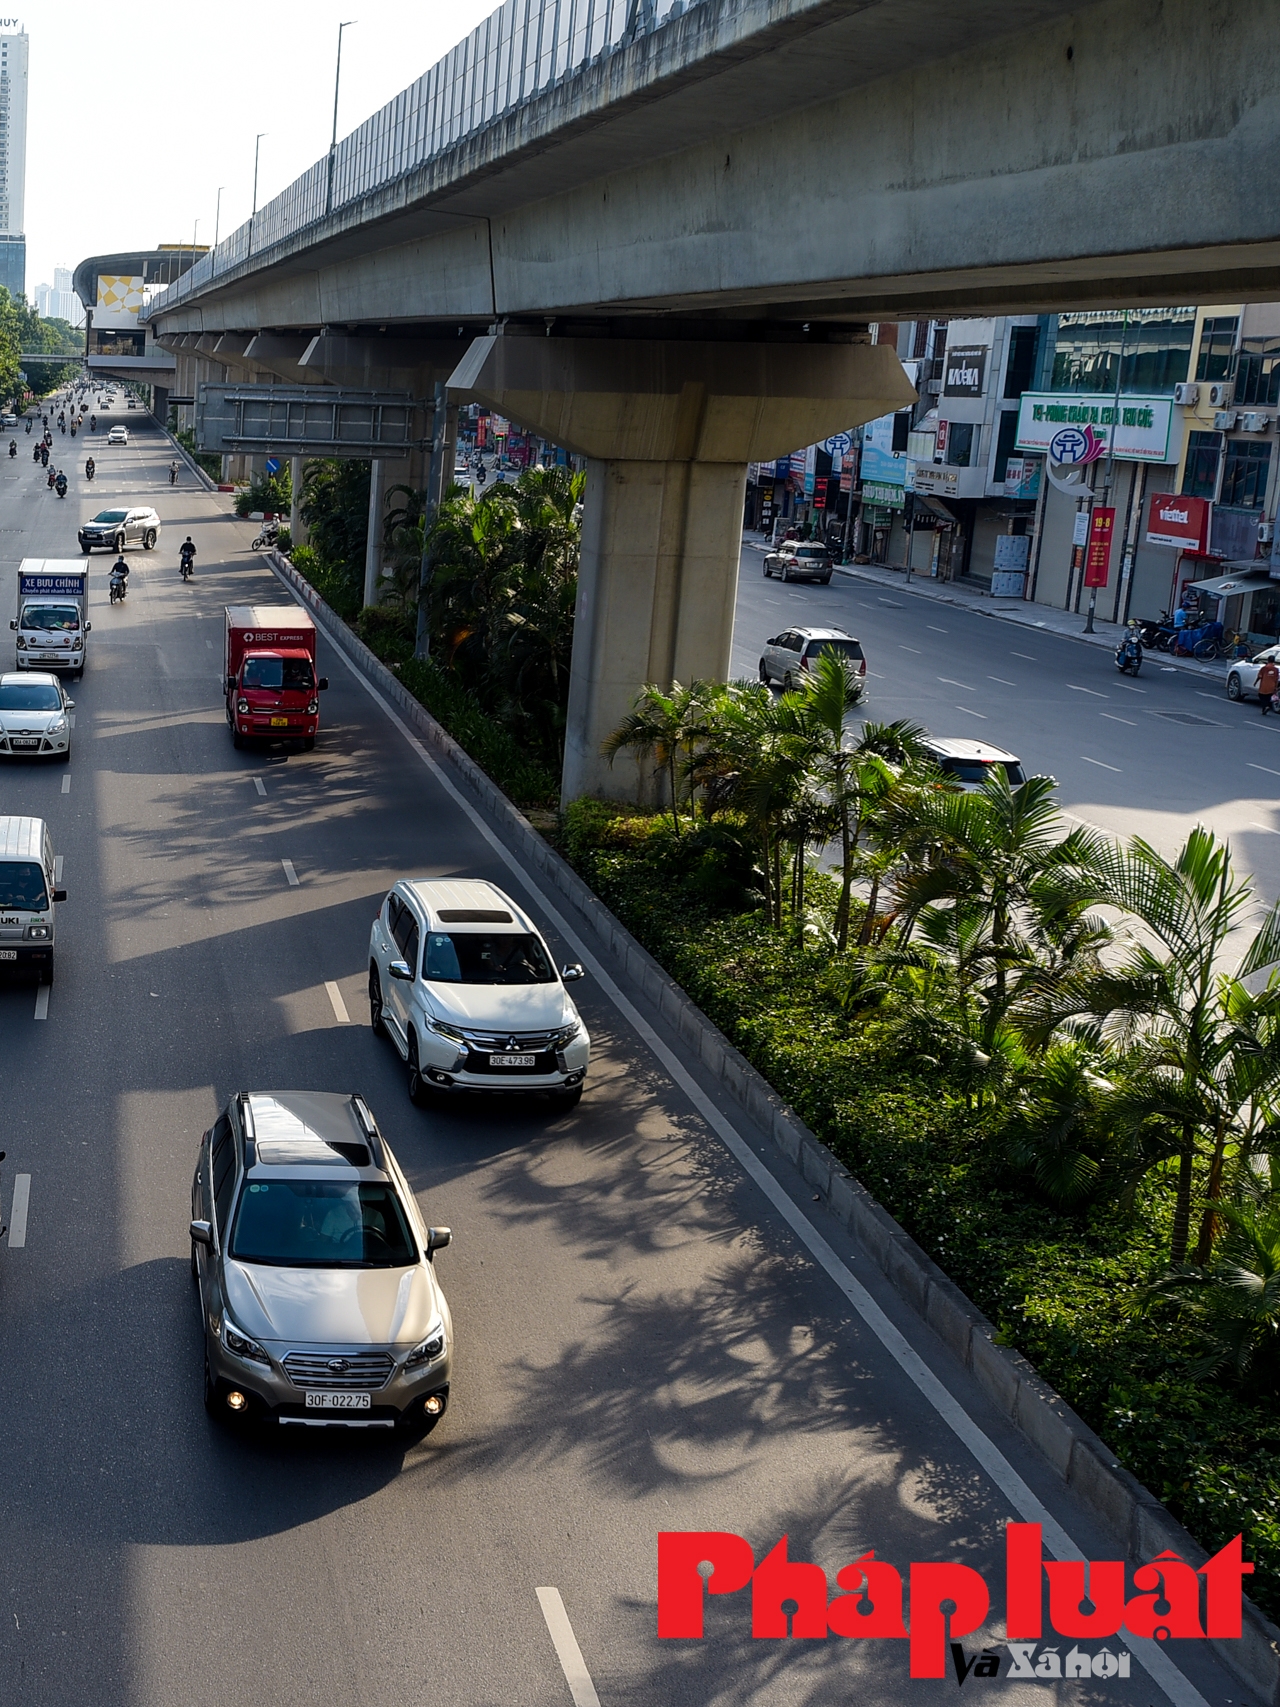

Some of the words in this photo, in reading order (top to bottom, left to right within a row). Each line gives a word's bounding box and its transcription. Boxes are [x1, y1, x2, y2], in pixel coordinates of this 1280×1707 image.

[25, 578, 35, 587] XE
[36, 578, 53, 587] BƯU
[55, 577, 80, 587] CHÍNH
[255, 633, 278, 642] BEST
[491, 1056, 535, 1065] 30E-473.96
[307, 1394, 369, 1407] 30F-022.75
